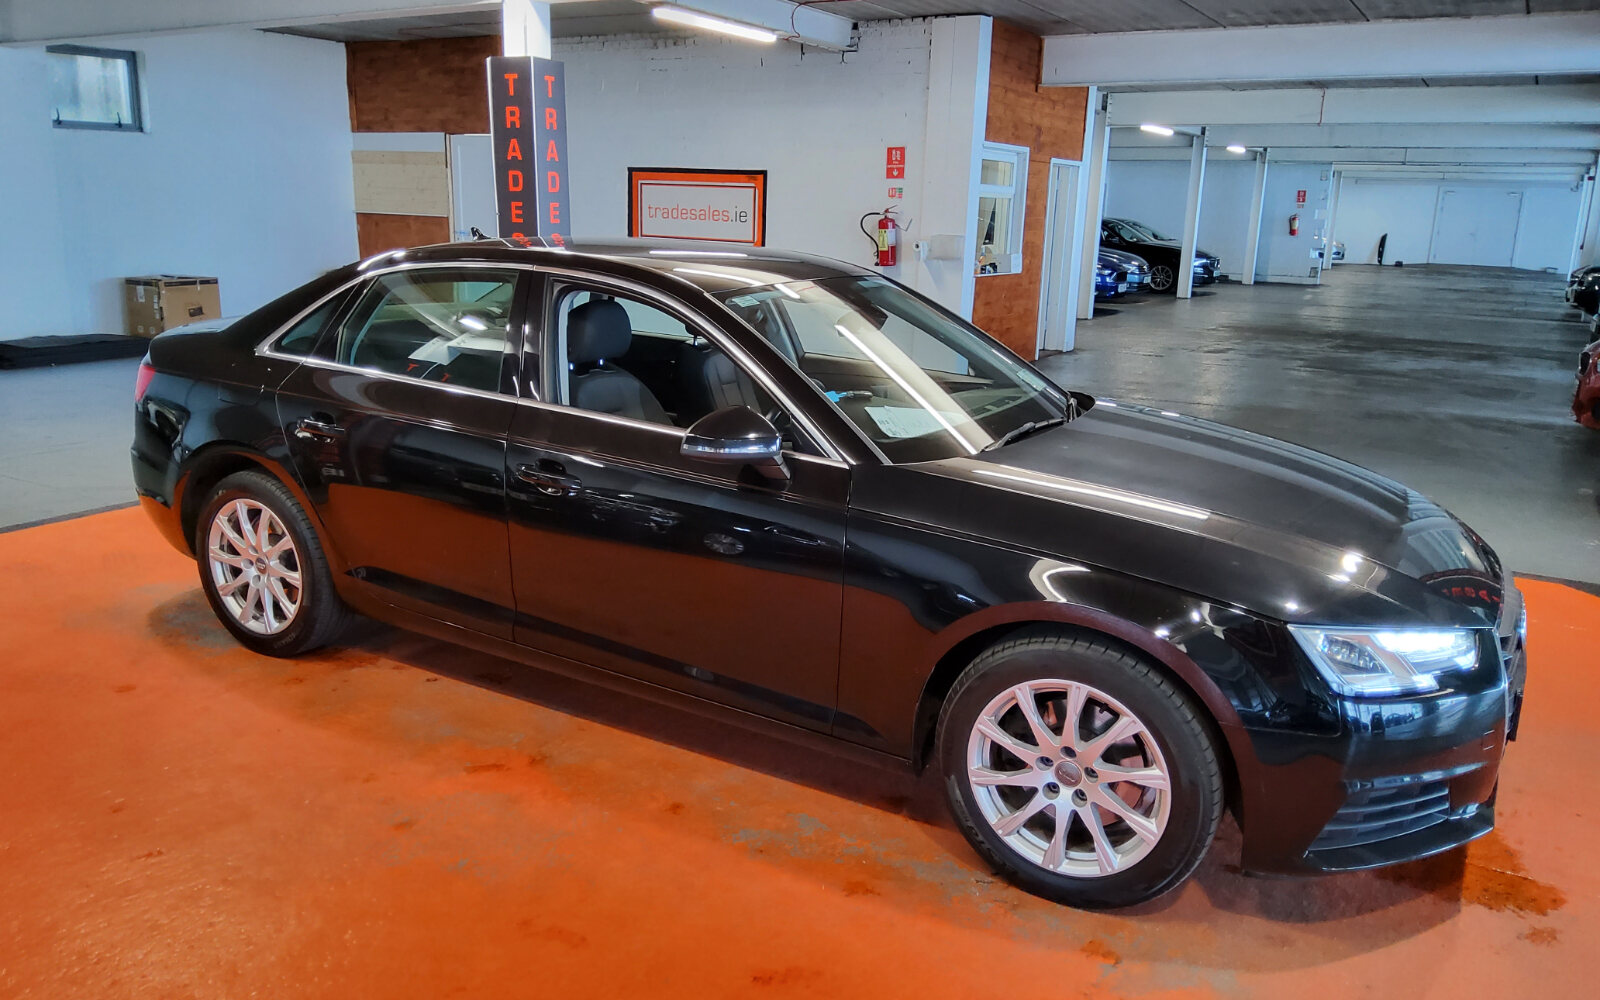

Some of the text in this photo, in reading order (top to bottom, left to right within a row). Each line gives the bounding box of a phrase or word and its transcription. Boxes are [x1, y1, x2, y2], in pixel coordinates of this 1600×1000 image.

[504, 73, 525, 239] TRADE
[544, 75, 561, 239] TRADE
[647, 203, 748, 223] tradesales.ie
